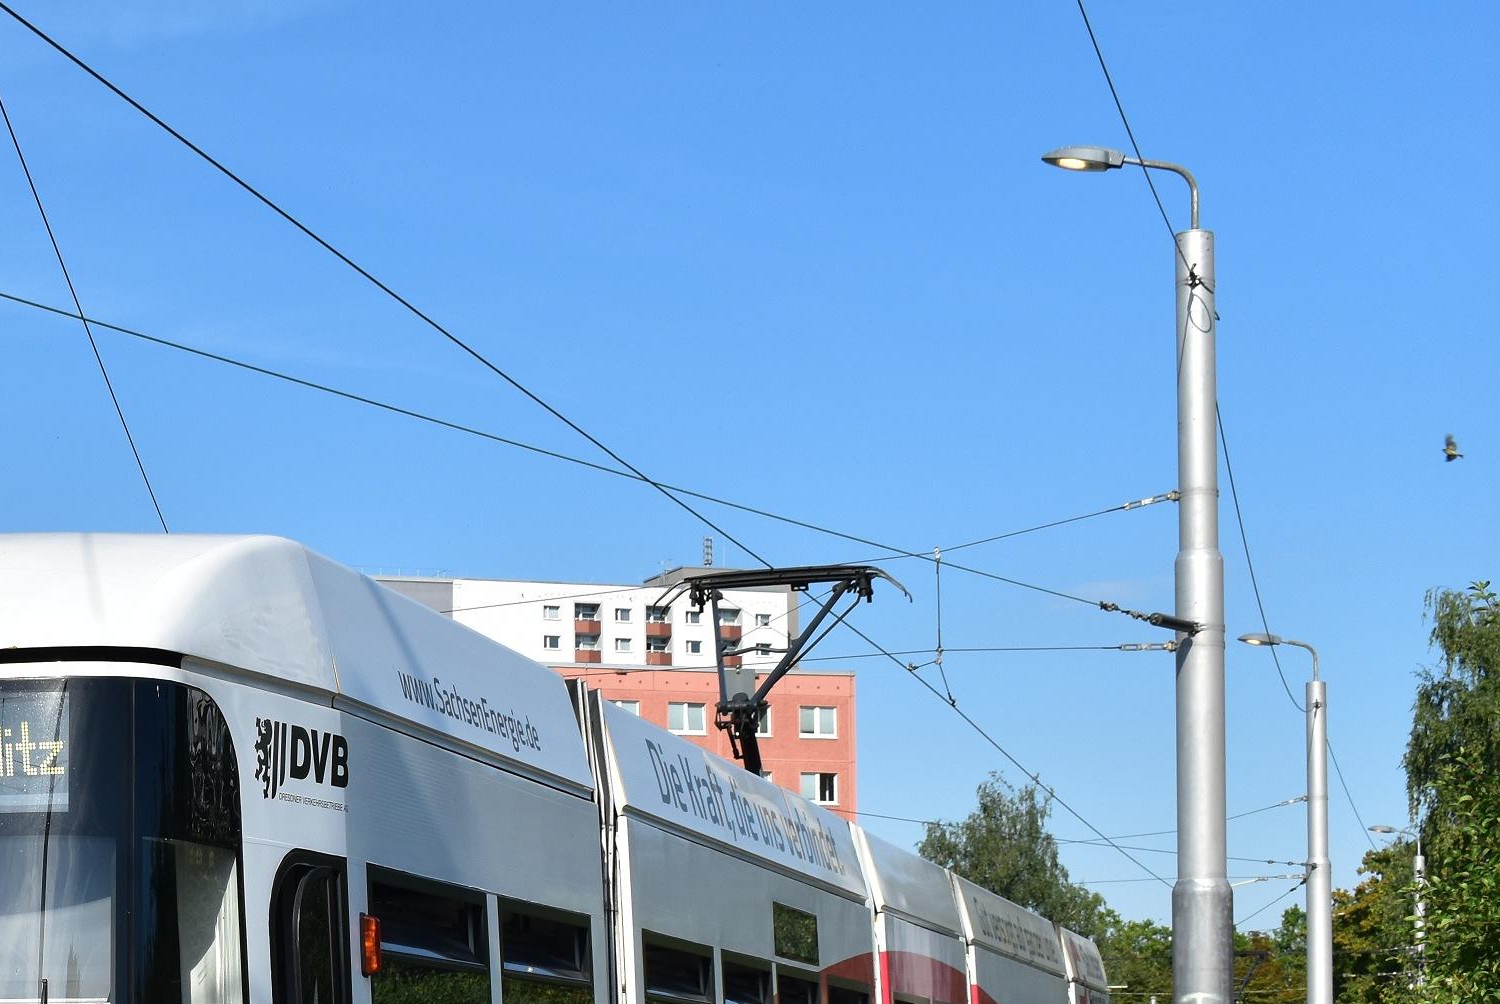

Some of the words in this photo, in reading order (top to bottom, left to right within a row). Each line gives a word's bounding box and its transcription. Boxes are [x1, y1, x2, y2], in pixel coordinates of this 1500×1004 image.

[397, 670, 541, 752] www.SachsenEnergie.de
[289, 724, 349, 789] DVB
[644, 738, 688, 813] Die
[677, 754, 738, 842] Kraft,
[729, 777, 760, 842] die
[755, 803, 786, 853] uns
